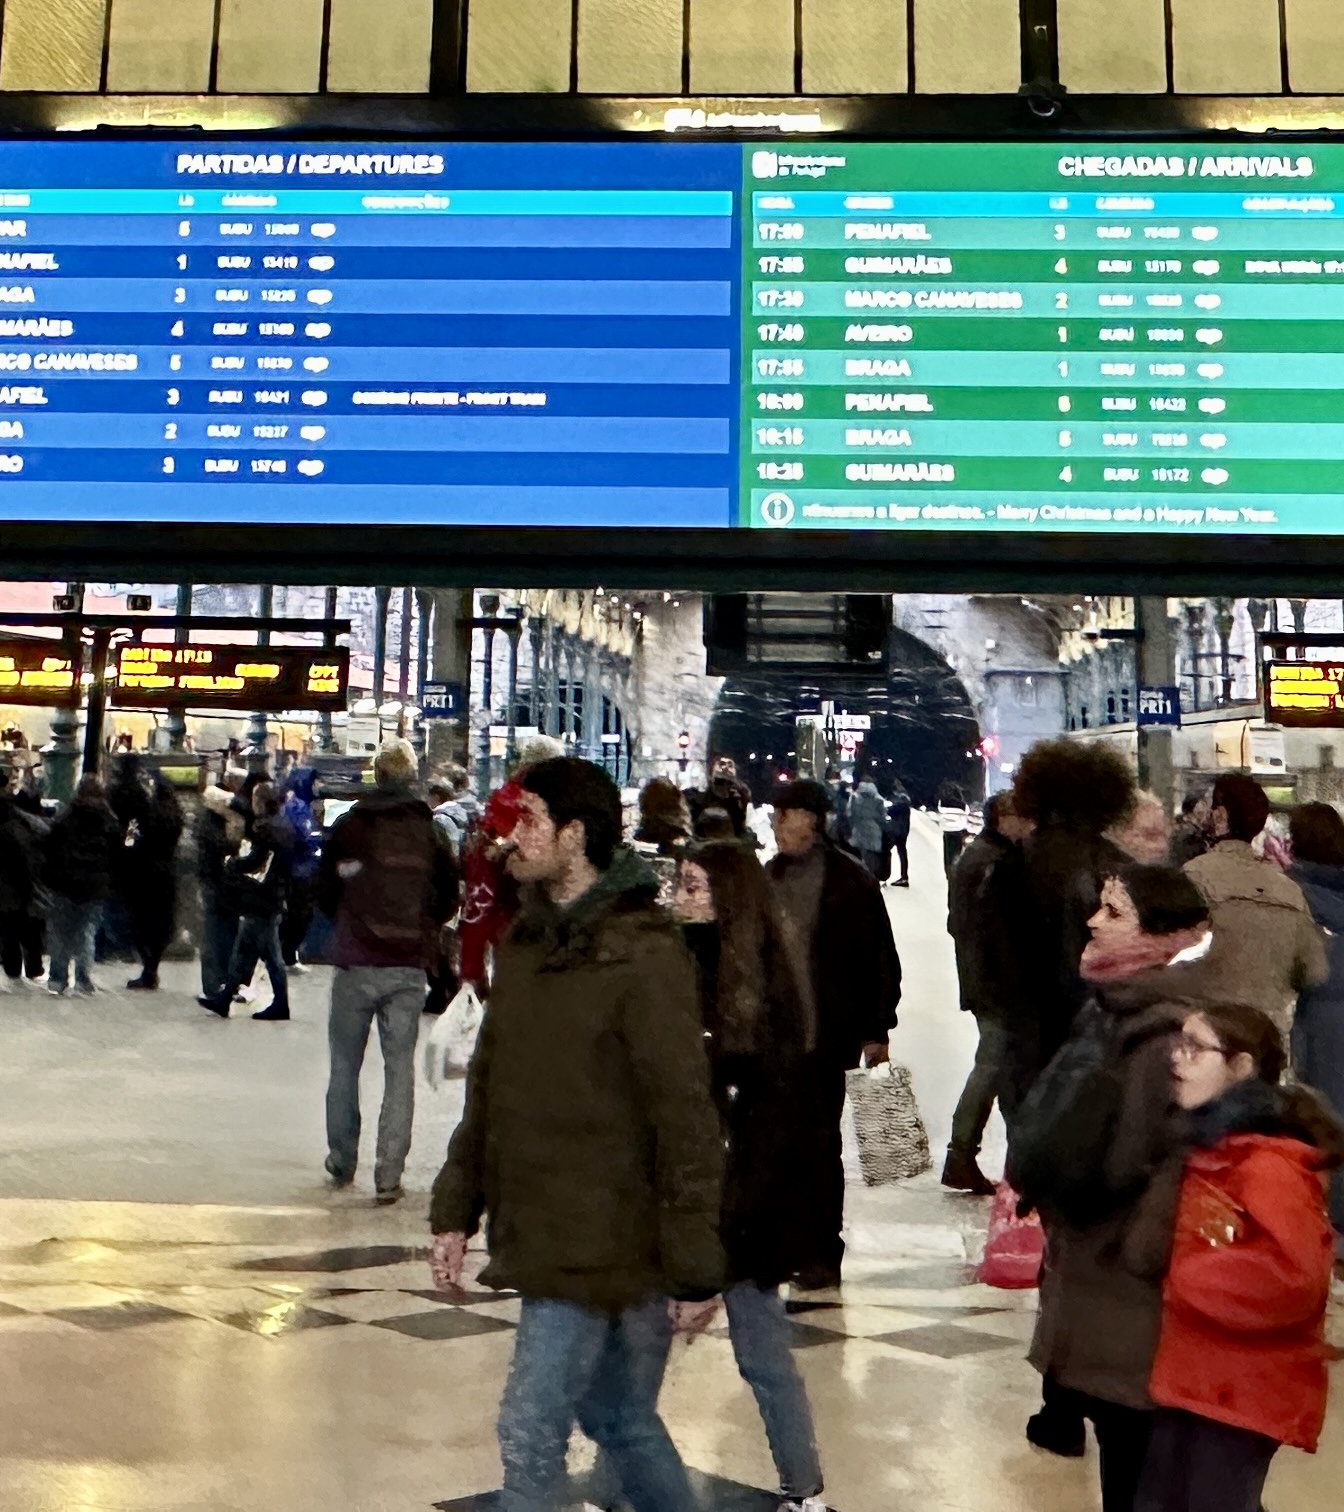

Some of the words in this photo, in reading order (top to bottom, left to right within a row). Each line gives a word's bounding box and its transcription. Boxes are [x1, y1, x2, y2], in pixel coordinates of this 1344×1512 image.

[178, 155, 283, 174] PARTIDAS
[287, 155, 296, 173] /
[299, 155, 444, 174] DEPARTURES
[1059, 157, 1184, 176] CHEGADAS
[1188, 157, 1197, 176] /
[1200, 157, 1312, 176] ARRIVALS
[1055, 225, 1065, 239] 3
[178, 255, 186, 269] 1
[1055, 258, 1067, 273] 4
[175, 288, 185, 302] 3
[1056, 293, 1067, 308] 2
[172, 321, 183, 336] 4
[1058, 327, 1066, 342] 1
[846, 360, 911, 376] BRAGA
[1059, 362, 1067, 376] 1
[168, 389, 179, 404] 3
[165, 424, 176, 439] 2
[846, 430, 911, 445] BRAGA
[1060, 467, 1071, 481] 4
[1040, 505, 1111, 520] Christmas
[1157, 505, 1204, 525] Happy
